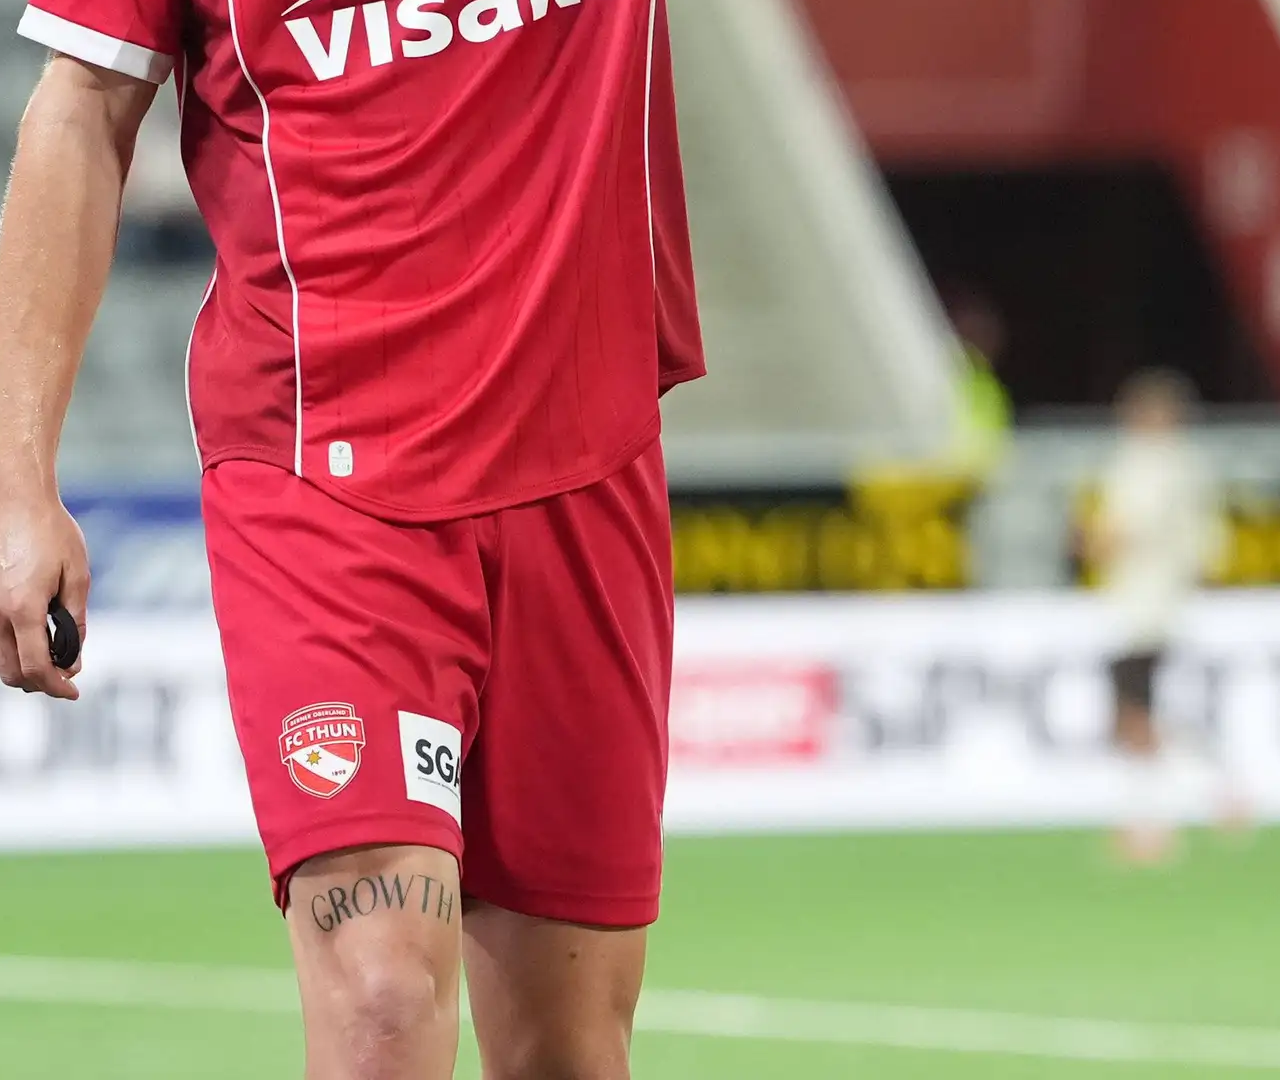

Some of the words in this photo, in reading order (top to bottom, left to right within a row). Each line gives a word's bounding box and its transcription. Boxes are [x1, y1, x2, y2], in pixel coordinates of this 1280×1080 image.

[285, 731, 303, 752] FC
[306, 723, 357, 742] THUN
[311, 873, 454, 933] GROWTH
